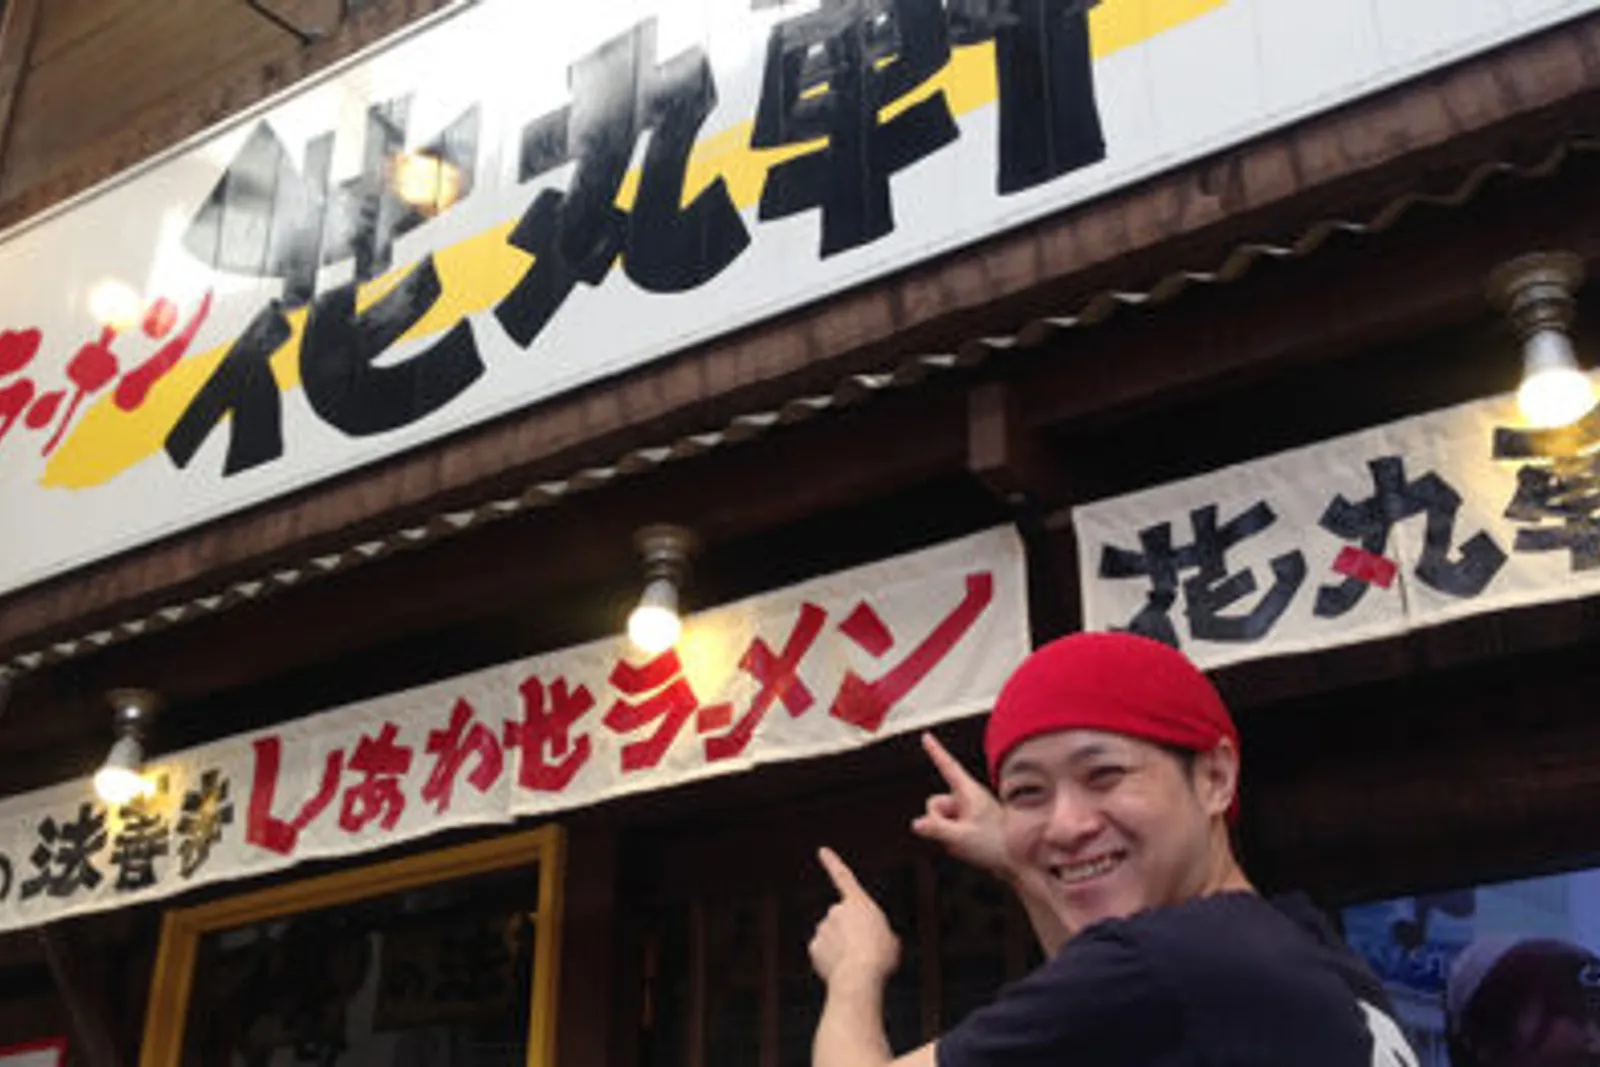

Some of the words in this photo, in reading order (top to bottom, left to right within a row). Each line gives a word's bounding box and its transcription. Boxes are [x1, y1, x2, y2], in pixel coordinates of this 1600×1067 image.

[164, 0, 1106, 476] 花丸軒
[246, 570, 993, 856] しあわせラーメン
